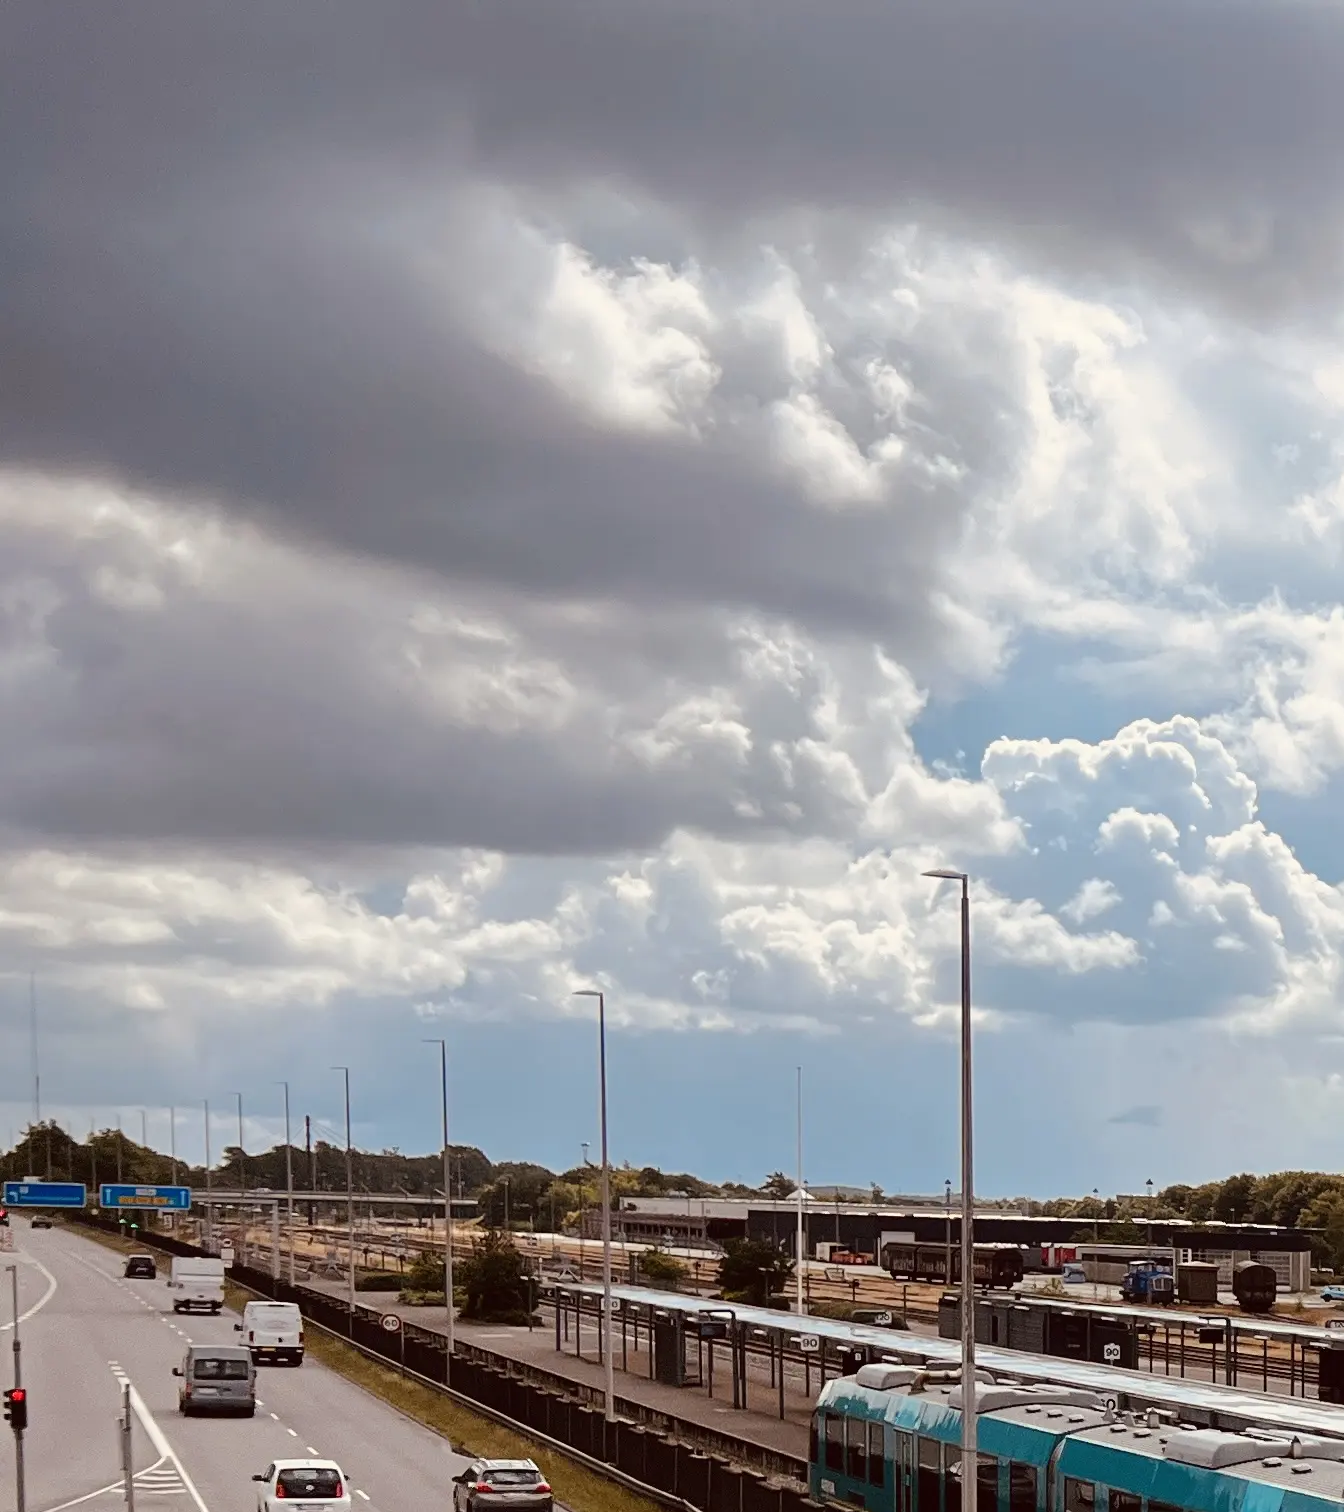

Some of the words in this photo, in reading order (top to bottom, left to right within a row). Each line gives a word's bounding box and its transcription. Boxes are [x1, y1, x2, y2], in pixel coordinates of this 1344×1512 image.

[384, 1319, 398, 1327] 60
[802, 1338, 818, 1348] 90
[1105, 1347, 1119, 1357] 90
